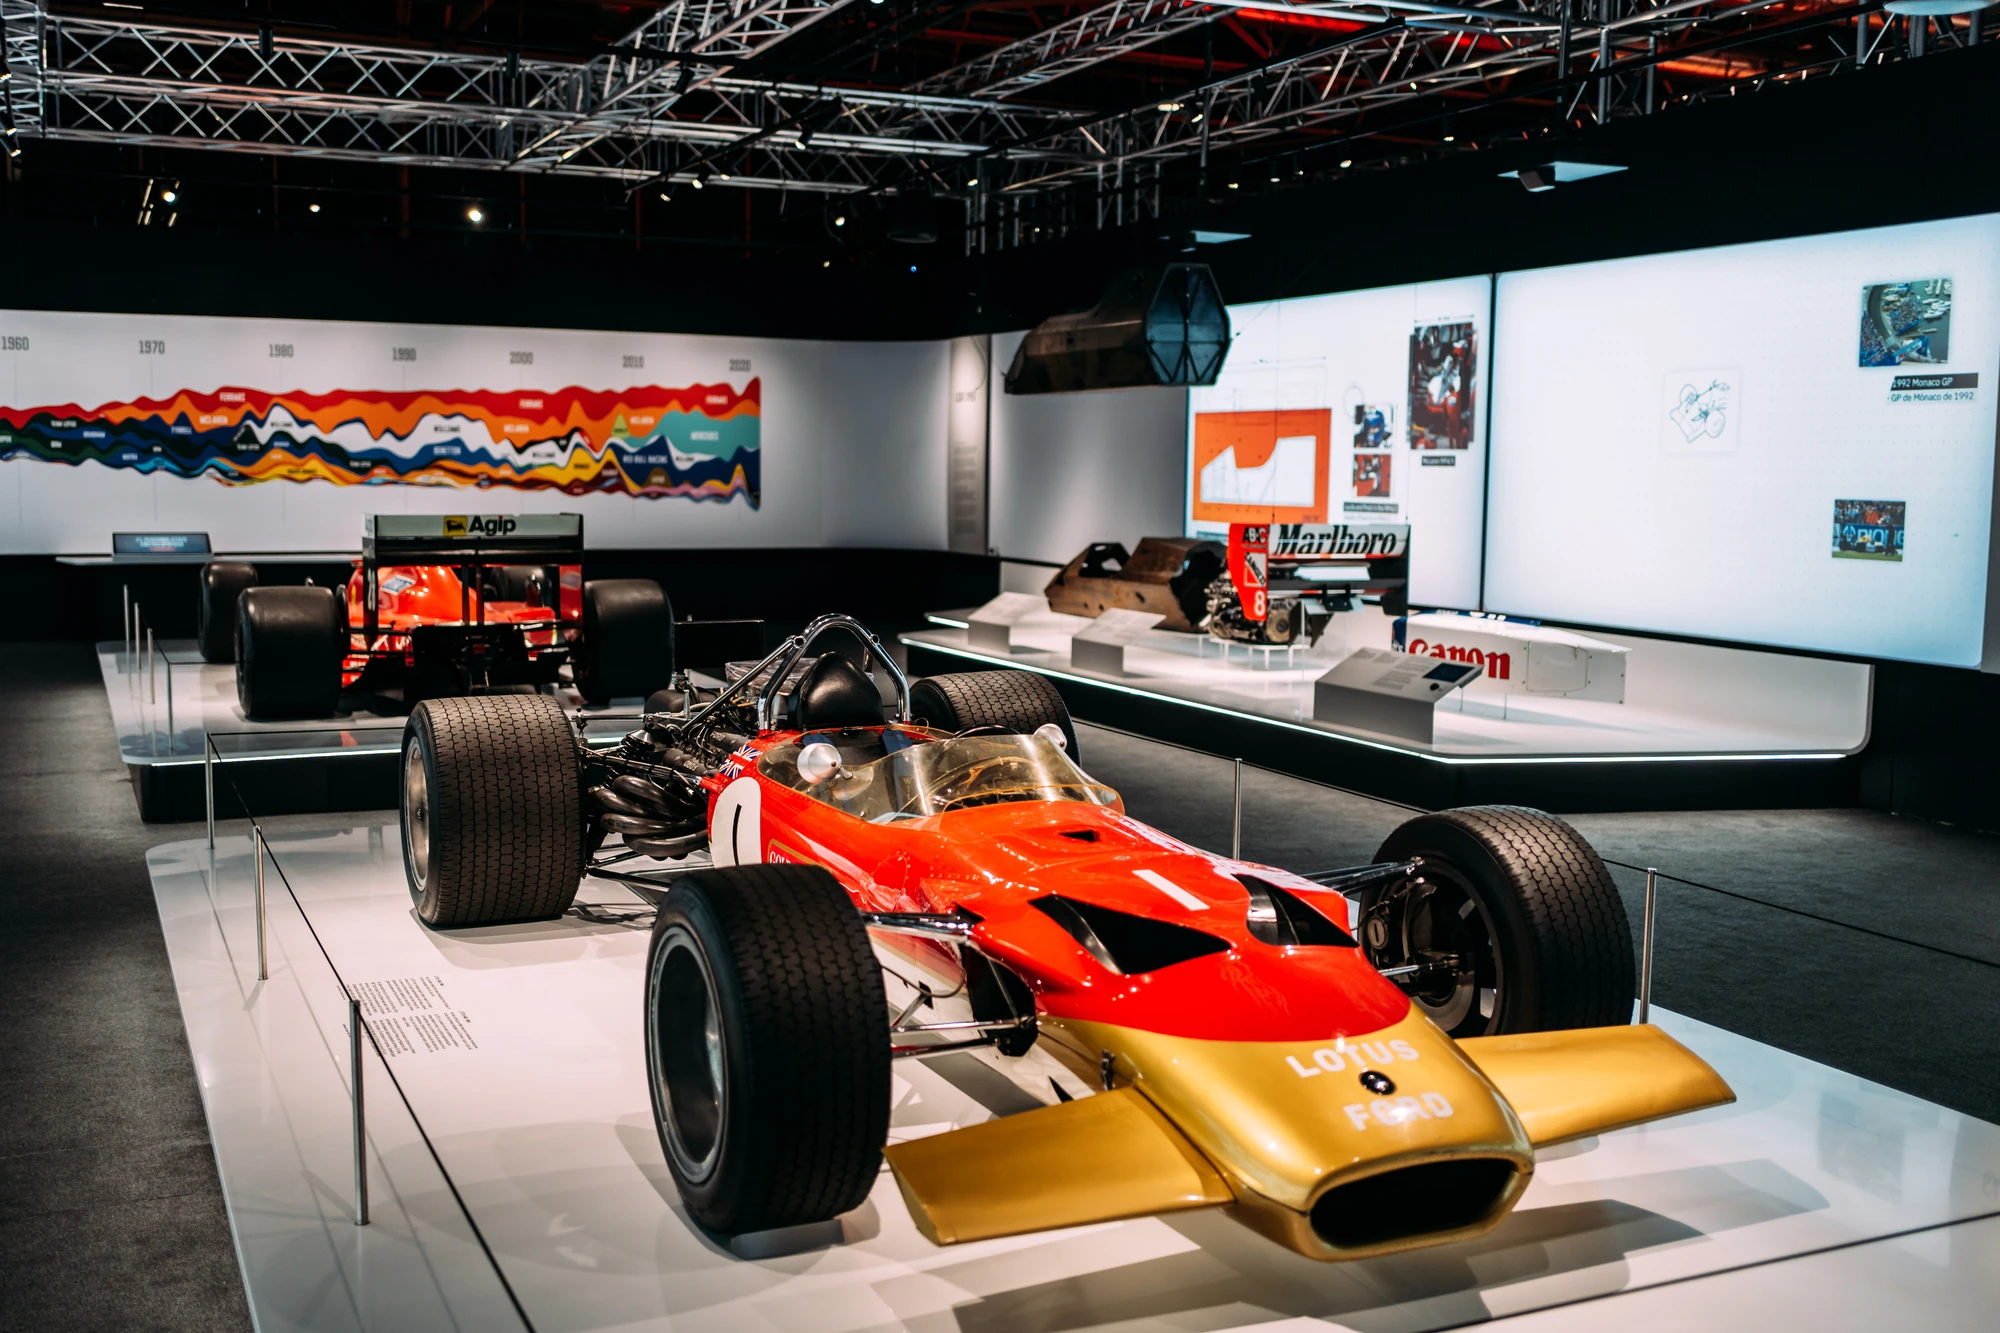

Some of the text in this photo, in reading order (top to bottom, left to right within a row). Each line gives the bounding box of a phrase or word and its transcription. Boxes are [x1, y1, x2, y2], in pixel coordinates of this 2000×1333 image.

[2, 336, 29, 351] 1960
[139, 340, 165, 354] 1970
[510, 351, 534, 364] 2000
[1893, 377, 1954, 388] 1992 Monaco GP
[1891, 393, 1902, 402] GP
[1902, 393, 1912, 401] de
[1943, 392, 1952, 400] de
[1954, 391, 1974, 400] 1992
[469, 516, 516, 536] Agip
[1273, 524, 1397, 554] Marlboro
[1254, 590, 1265, 616] 8
[732, 803, 742, 866] 1
[1285, 1039, 1420, 1078] LOTUS
[1343, 1091, 1454, 1131] FORD
